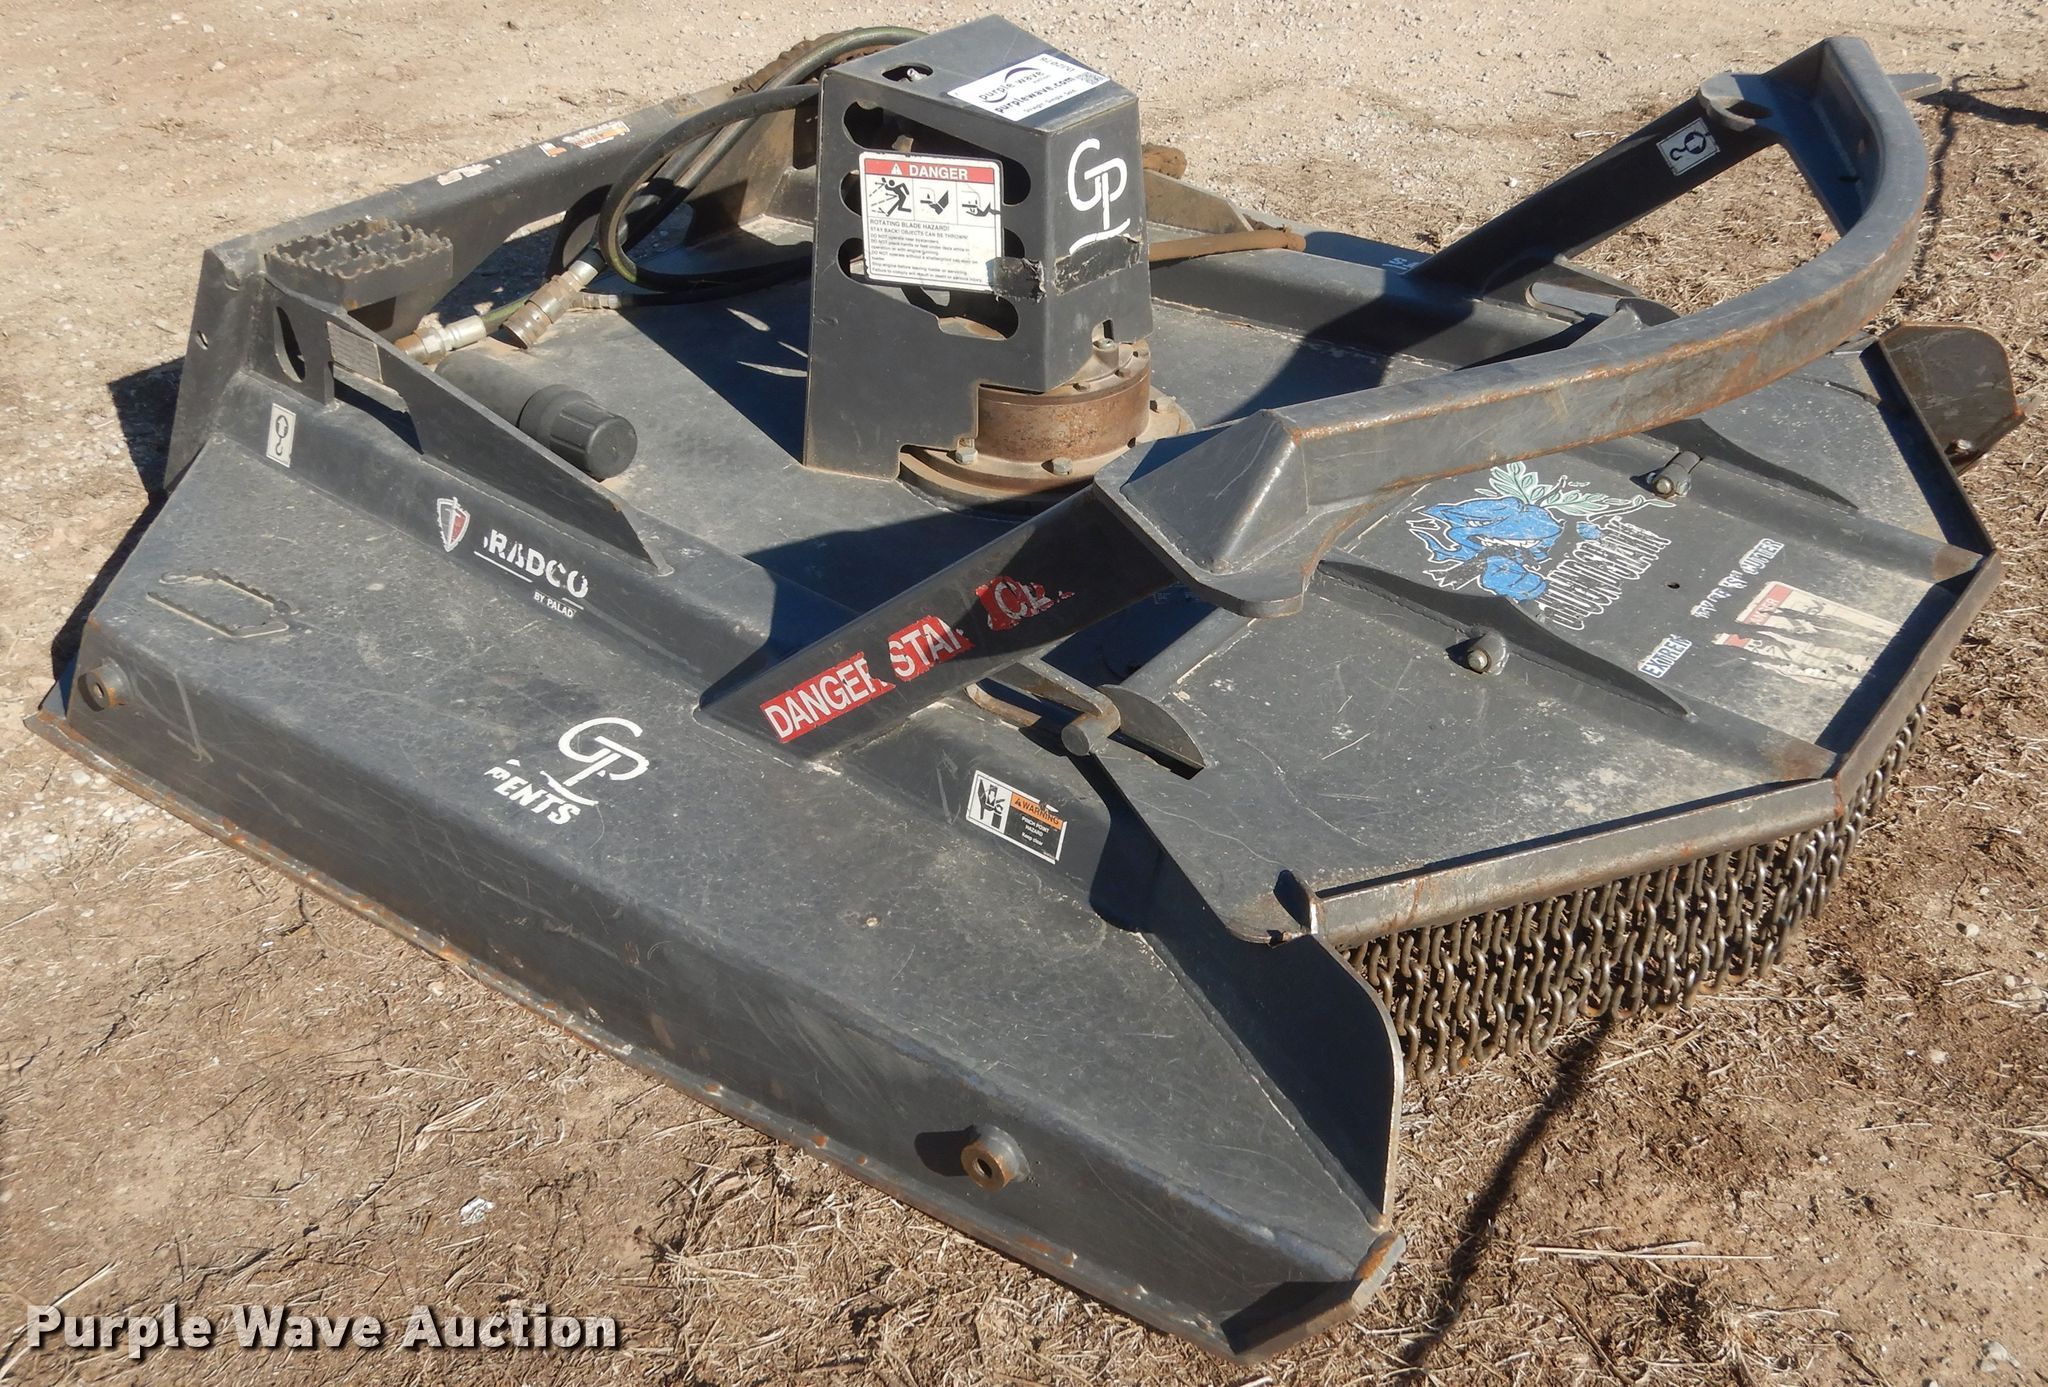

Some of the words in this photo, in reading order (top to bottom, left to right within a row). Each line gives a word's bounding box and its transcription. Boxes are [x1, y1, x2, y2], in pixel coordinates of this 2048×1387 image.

[978, 80, 1015, 101] purple
[994, 76, 1076, 114] purplewave.com
[908, 163, 969, 181] DANGER
[870, 219, 900, 227] ROTATING
[901, 221, 921, 229] BLADE
[484, 529, 589, 598] RADCO
[533, 591, 546, 603] BY
[546, 598, 575, 618] PALAD
[888, 617, 964, 678] STA
[1022, 800, 1060, 825] WARNING
